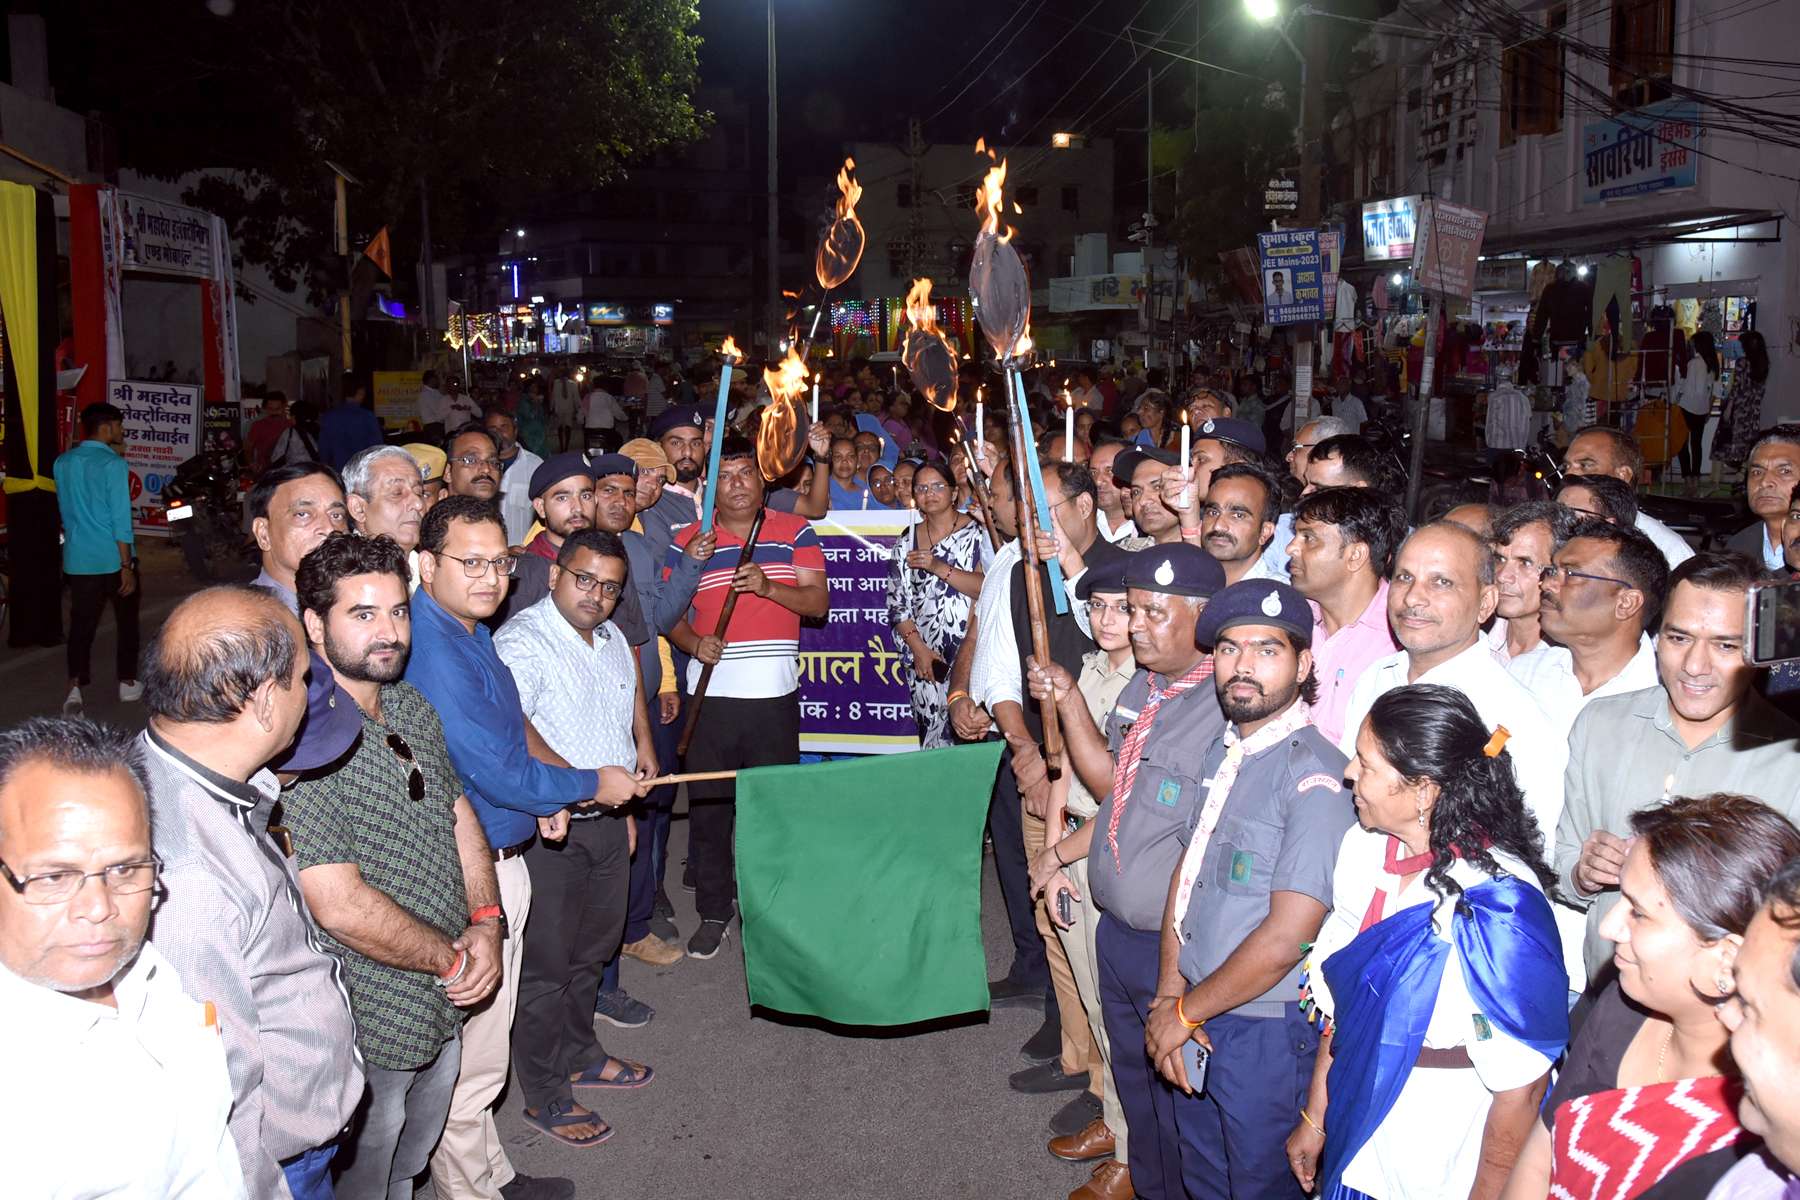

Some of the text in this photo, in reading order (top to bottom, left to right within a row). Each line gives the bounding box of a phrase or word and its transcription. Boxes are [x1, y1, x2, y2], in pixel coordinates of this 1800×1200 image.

[1263, 258, 1277, 268] JEE
[114, 385, 192, 406] श्री महादेव
[121, 404, 191, 425] लेक्ट्रोनिक्स
[862, 608, 889, 626] मह
[799, 651, 865, 688] शाल
[848, 702, 862, 721] 8
